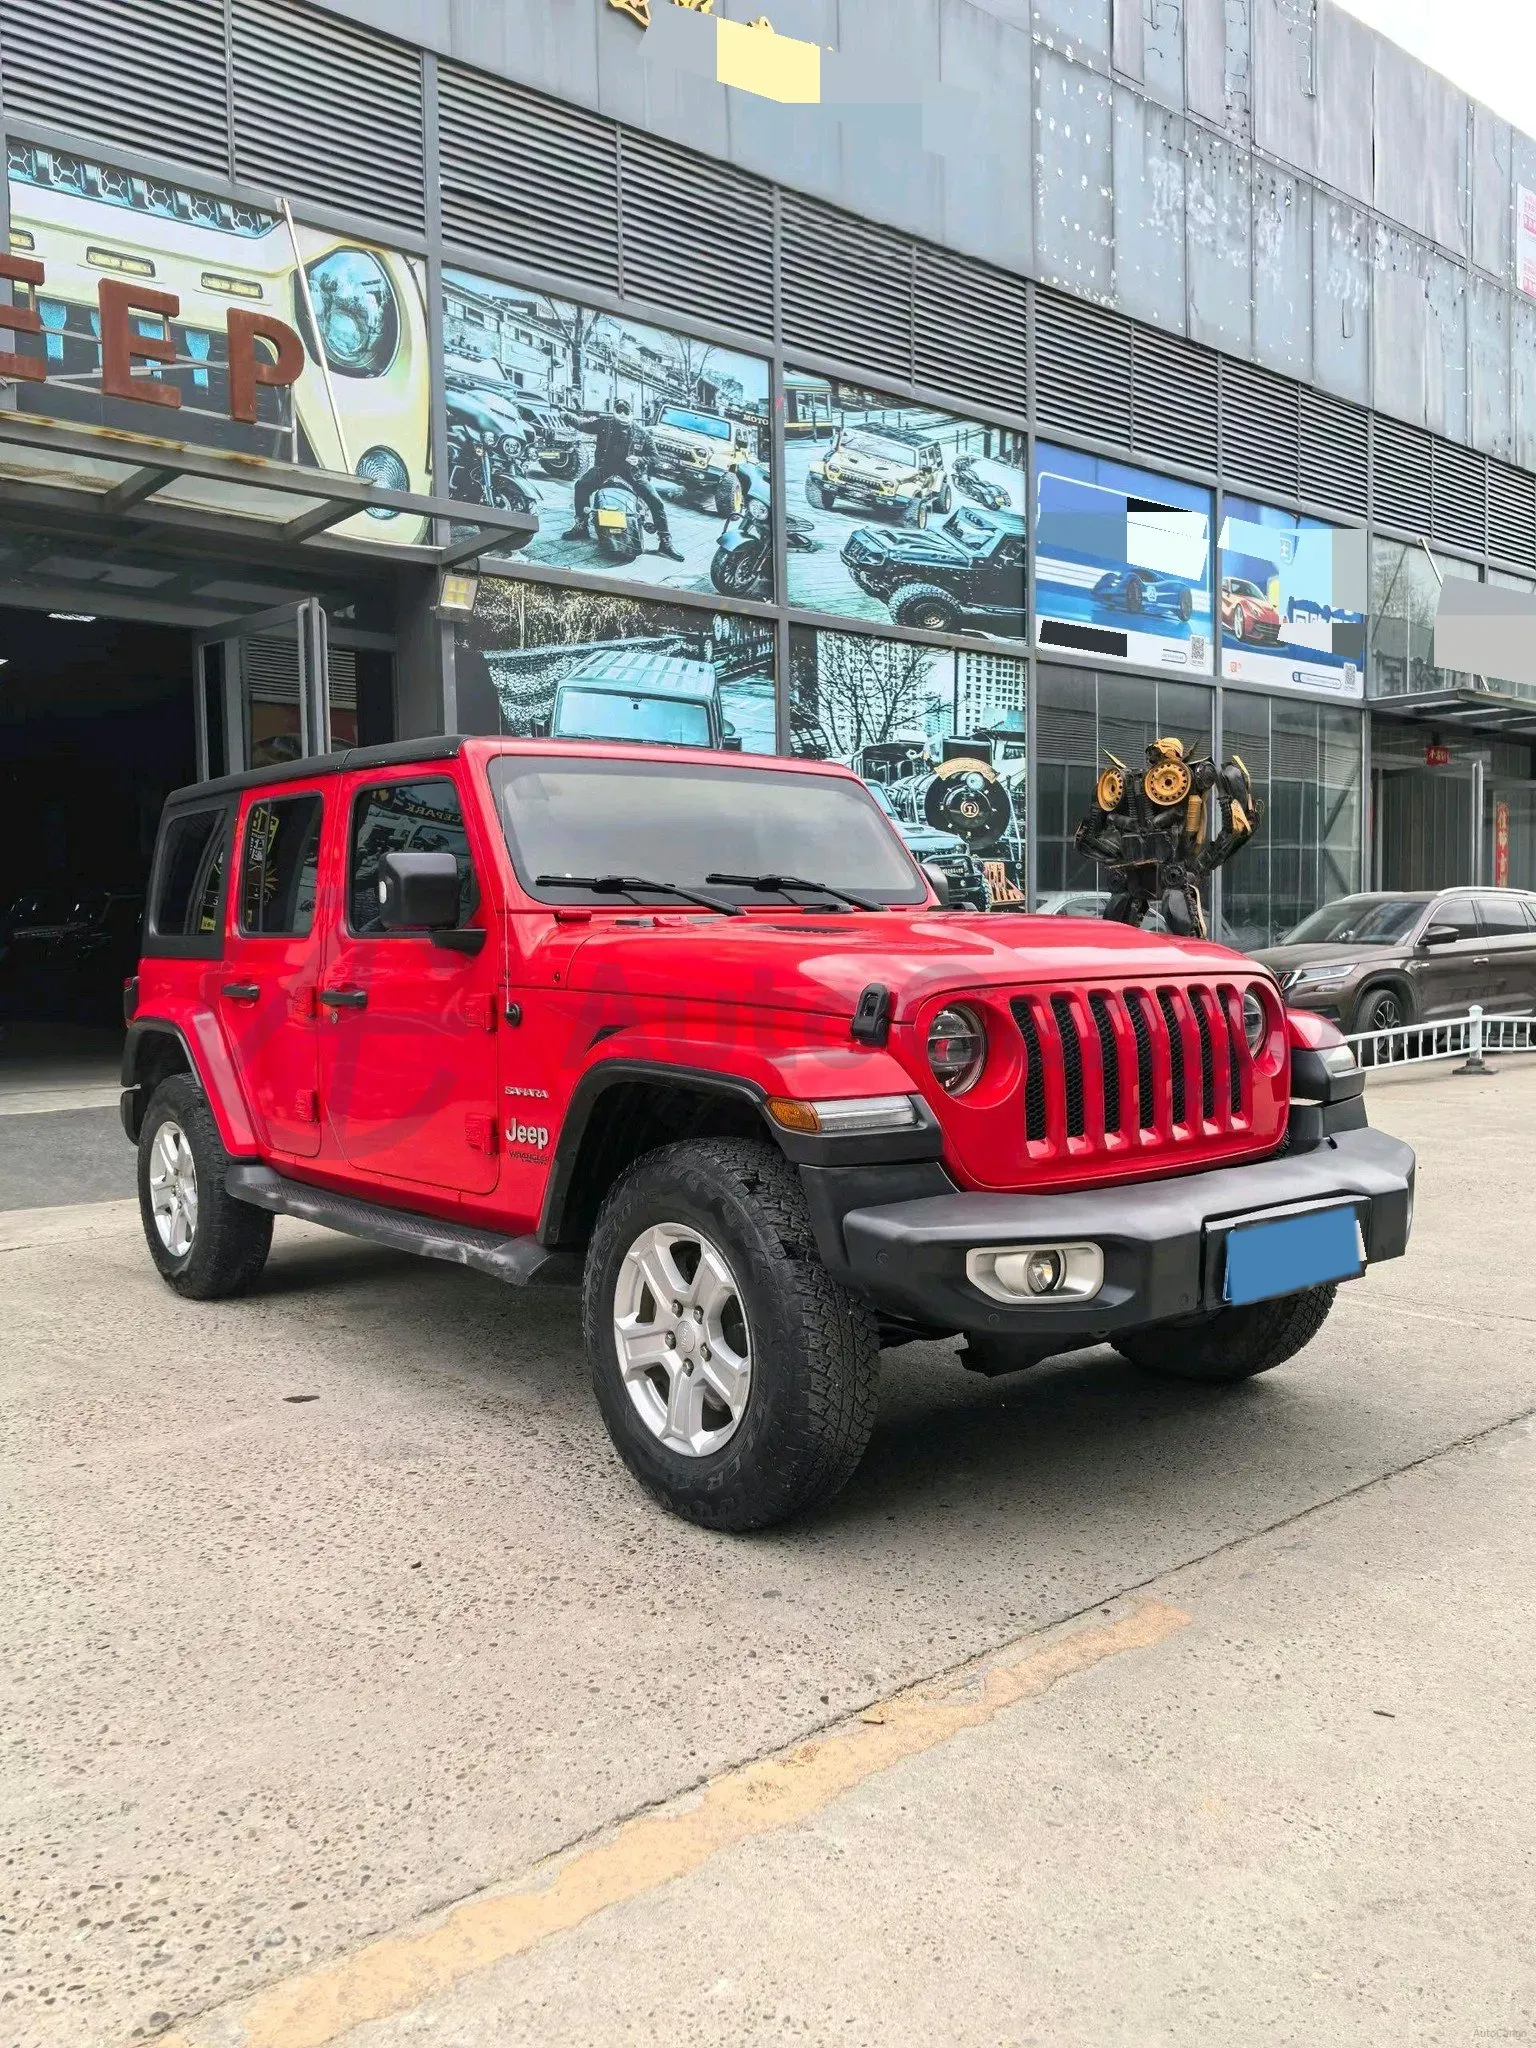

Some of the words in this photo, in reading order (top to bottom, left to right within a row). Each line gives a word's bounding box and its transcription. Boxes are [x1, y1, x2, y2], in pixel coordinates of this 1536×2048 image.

[743, 414, 769, 426] MOTO
[504, 1086, 549, 1098] SAHARA
[505, 1117, 549, 1150] Jeep
